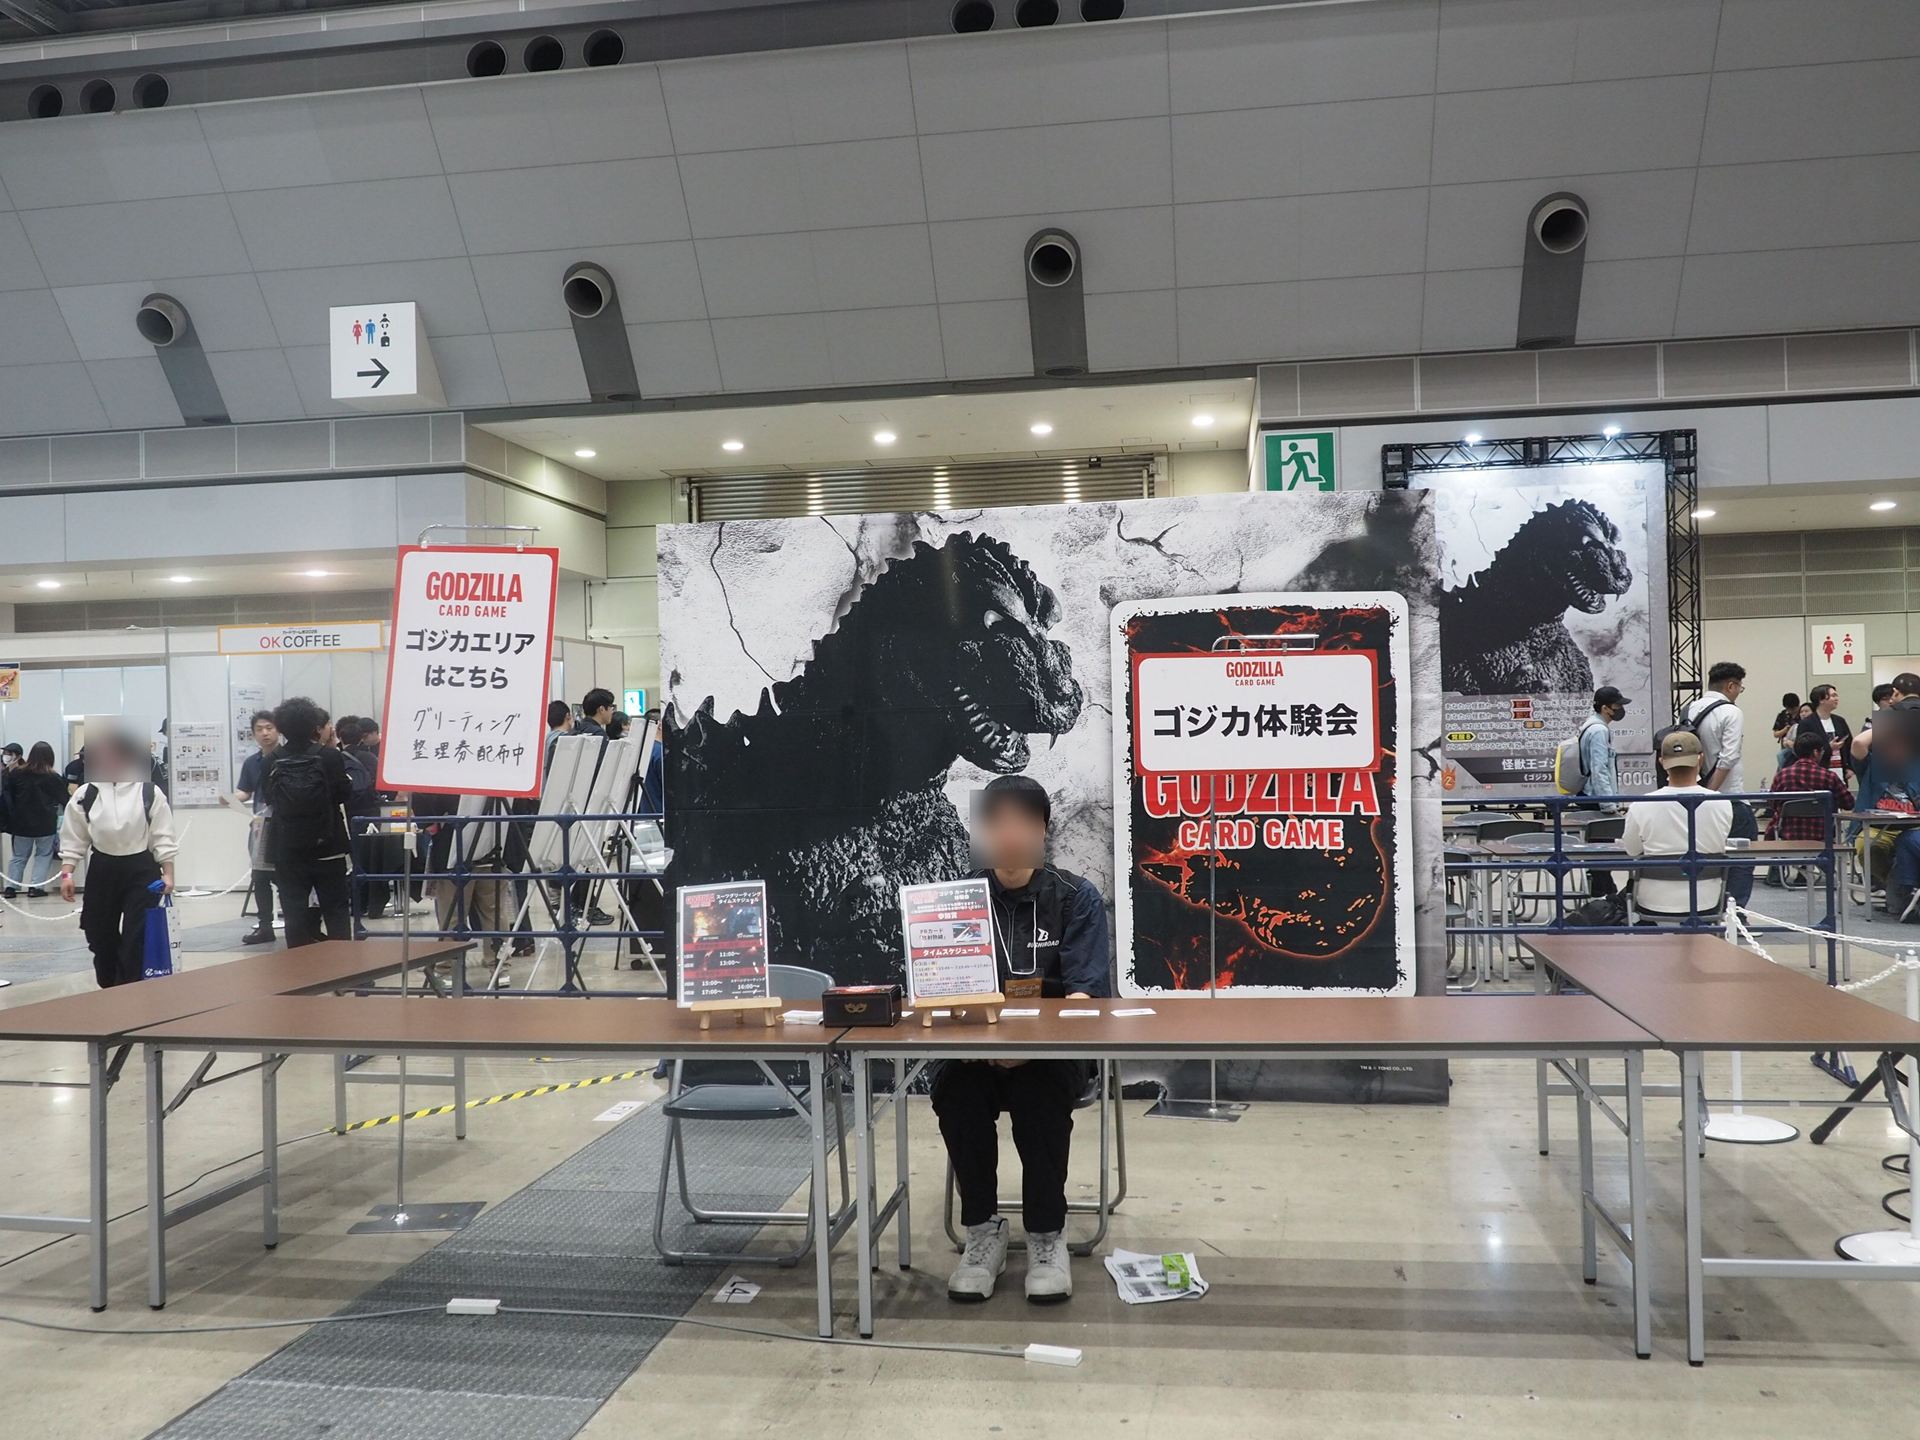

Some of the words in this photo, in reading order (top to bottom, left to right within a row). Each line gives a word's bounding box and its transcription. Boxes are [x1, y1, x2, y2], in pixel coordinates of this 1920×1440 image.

[426, 571, 523, 602] GODZILLA
[438, 604, 470, 617] CARD
[475, 605, 507, 618] GAME
[259, 636, 281, 649] OK
[283, 634, 341, 648] COFFEE
[405, 628, 536, 655] ゴジカエリア
[425, 664, 509, 690] はこちら
[1226, 661, 1284, 678] GODZILLA
[413, 706, 521, 735] グリーティング
[1153, 703, 1358, 738] ゴジカ体験会
[412, 738, 525, 766] 整理券配布中
[1143, 772, 1381, 818] GODZILLA
[1179, 820, 1257, 850] CARD
[1264, 818, 1344, 850] GAME
[922, 947, 981, 957] タイムスケジュール
